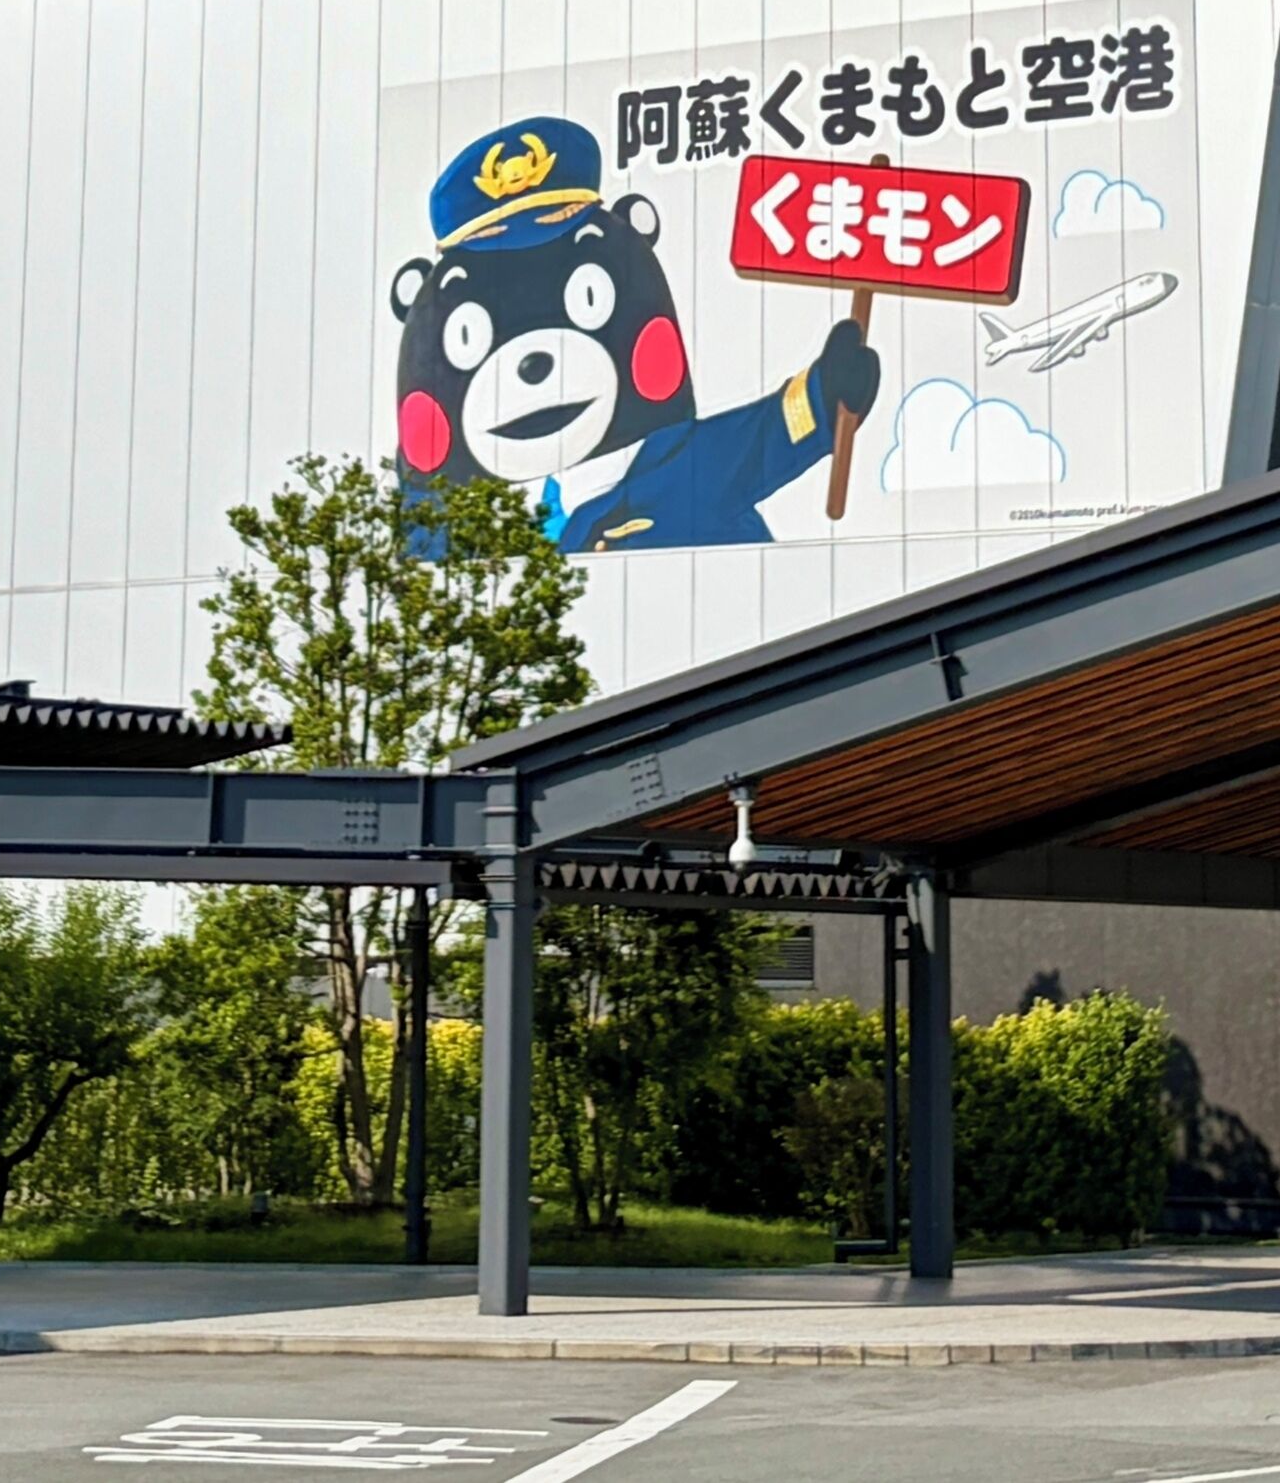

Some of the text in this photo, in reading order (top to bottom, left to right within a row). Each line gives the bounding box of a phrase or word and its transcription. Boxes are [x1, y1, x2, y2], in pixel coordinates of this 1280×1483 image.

[617, 24, 1176, 170] 阿蘇くまもと空港
[750, 173, 1005, 270] くまモン
